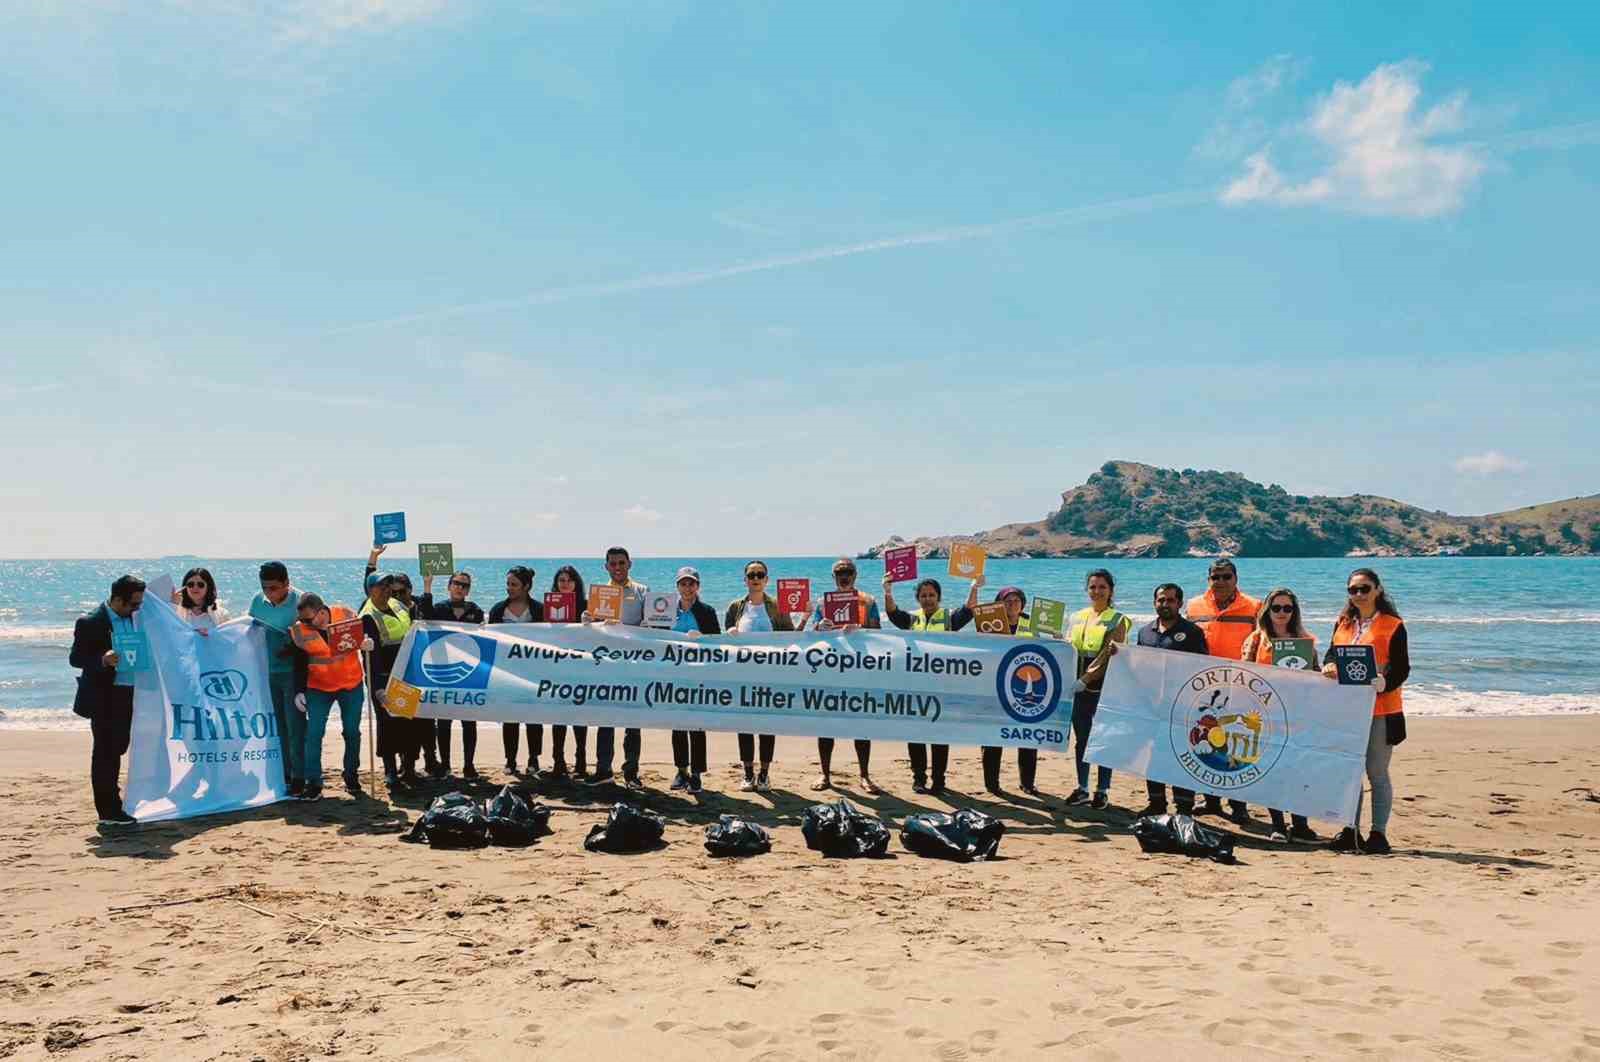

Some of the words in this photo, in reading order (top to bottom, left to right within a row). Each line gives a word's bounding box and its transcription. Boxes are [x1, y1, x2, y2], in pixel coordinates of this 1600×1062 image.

[507, 643, 585, 663] Avrupa
[592, 646, 656, 666] Çevre
[661, 644, 729, 666] Ajansı
[736, 647, 799, 666] Deniz
[805, 647, 892, 674] Çöpleri
[905, 646, 983, 676] İzleme
[443, 691, 487, 706] FLAG
[536, 679, 638, 706] Programı
[644, 681, 733, 708] (Marine
[740, 685, 796, 709] Litter
[802, 687, 942, 723] Watch-MLV)
[1191, 669, 1273, 706] ORTACA
[169, 703, 280, 741] Hilton
[1000, 727, 1064, 745] SARÇED
[177, 752, 228, 763] HOTELS
[231, 751, 240, 762] &
